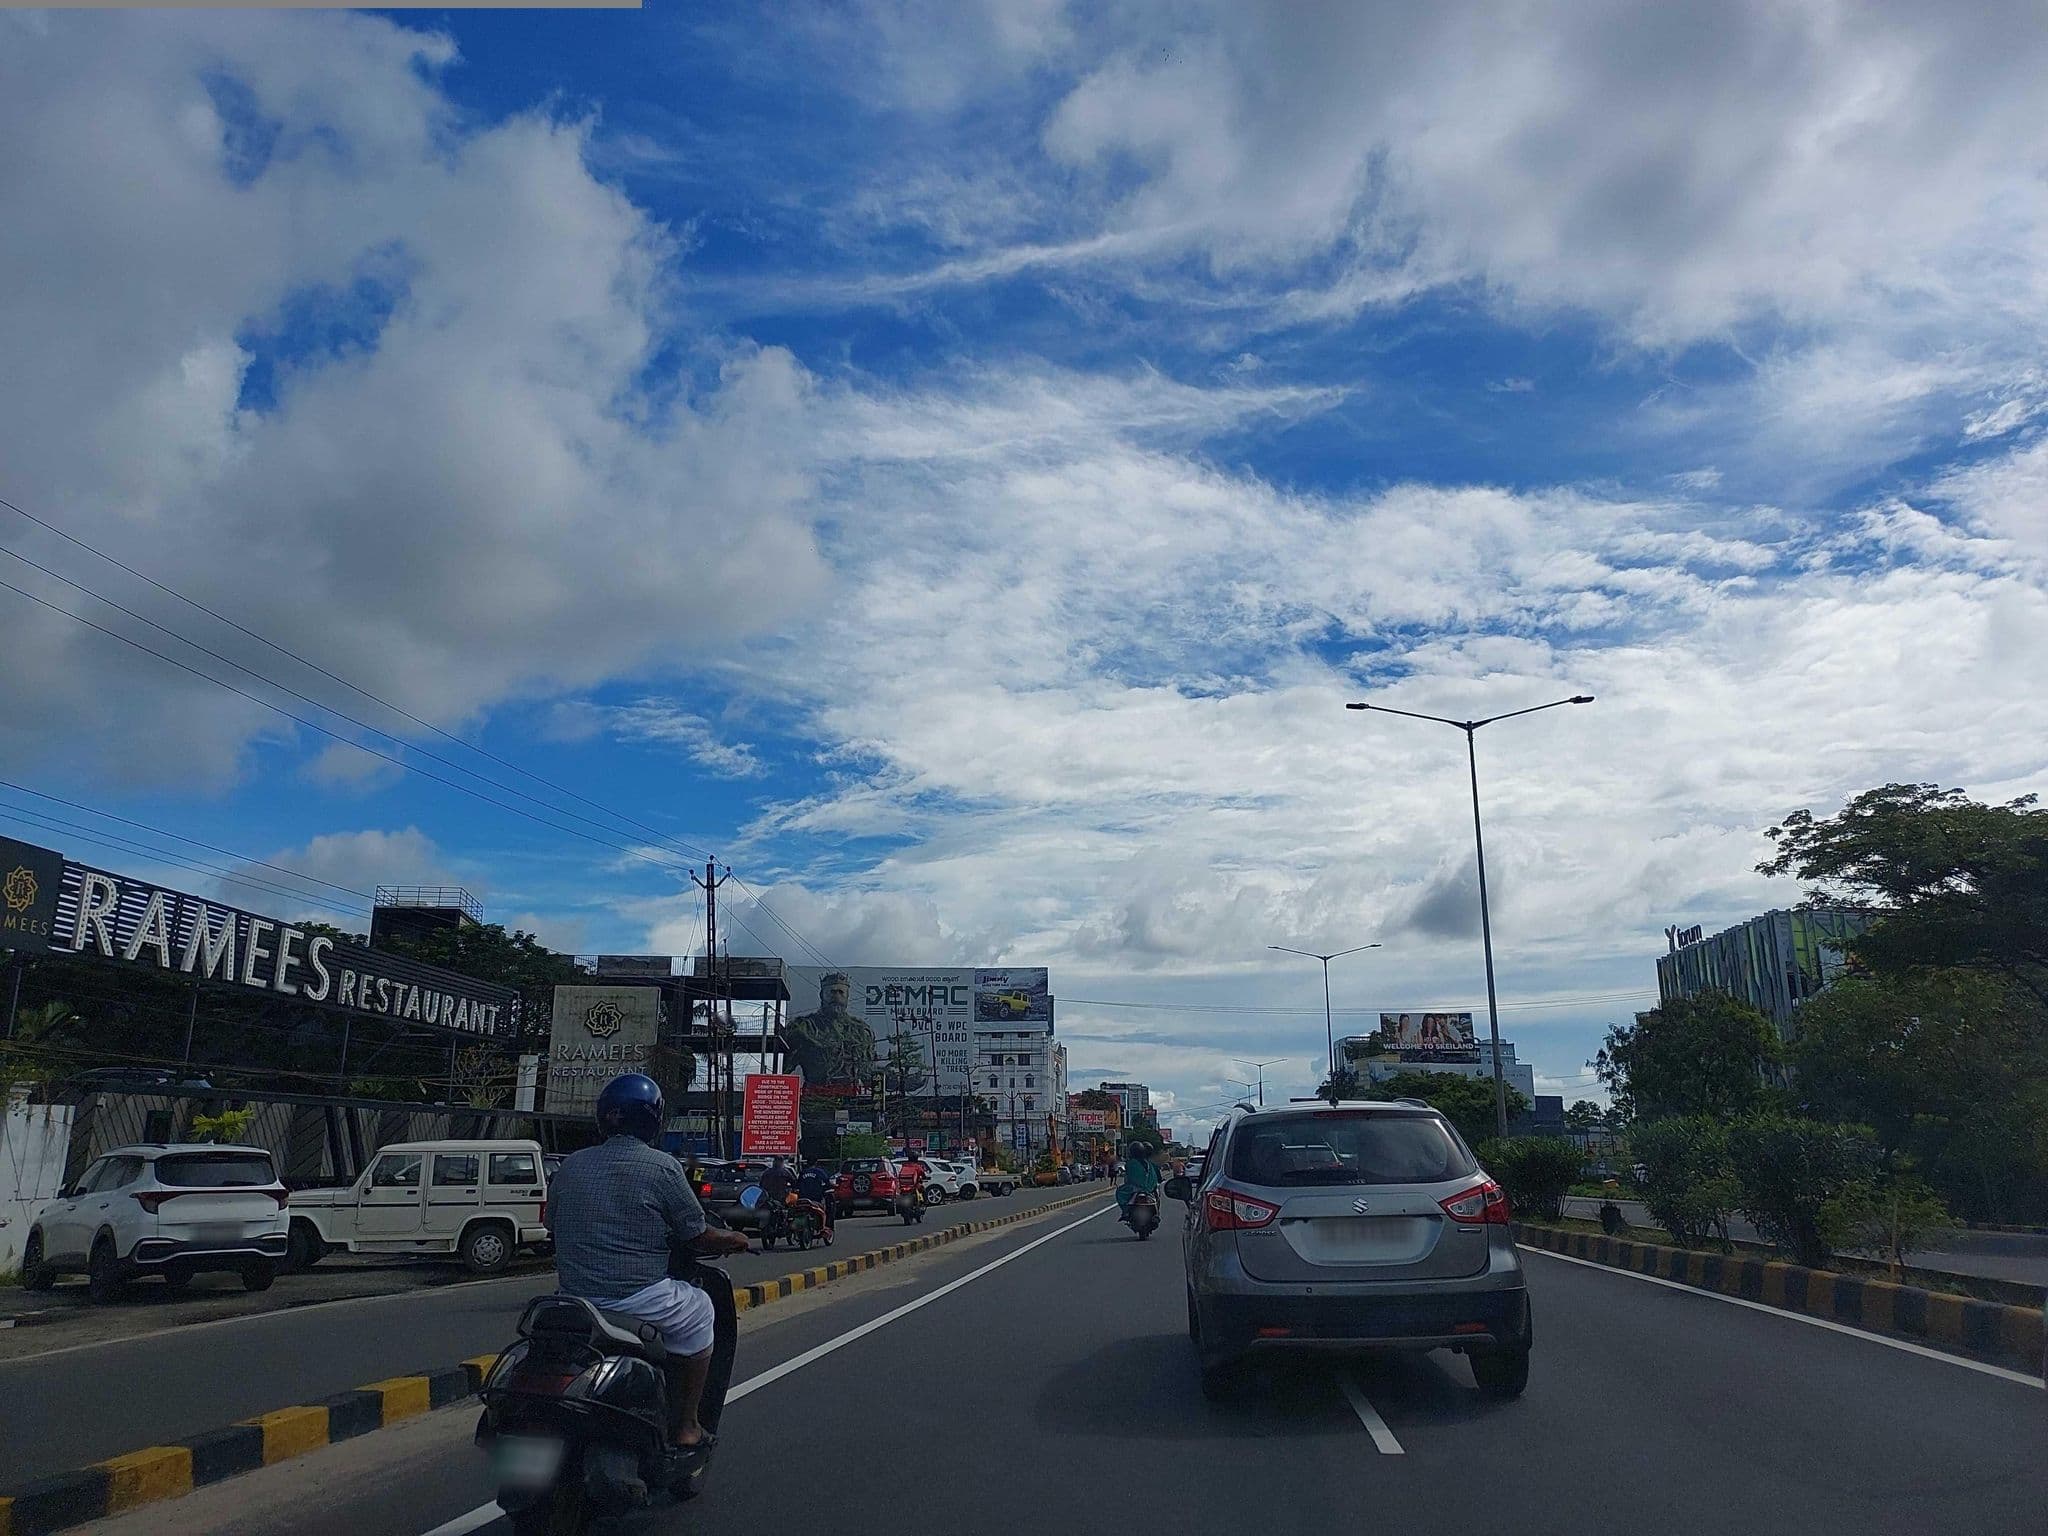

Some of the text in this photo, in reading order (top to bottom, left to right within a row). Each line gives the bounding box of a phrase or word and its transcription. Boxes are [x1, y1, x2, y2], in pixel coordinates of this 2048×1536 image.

[71, 871, 500, 1036] RAMEES RESTAURANT
[866, 985, 969, 1006] DEMAC
[912, 1021, 930, 1031] PVC
[948, 1021, 968, 1031] WPC
[935, 1032, 968, 1042] BOARD
[556, 1044, 645, 1061] RAMEES
[552, 1066, 649, 1078] RESTAURANT
